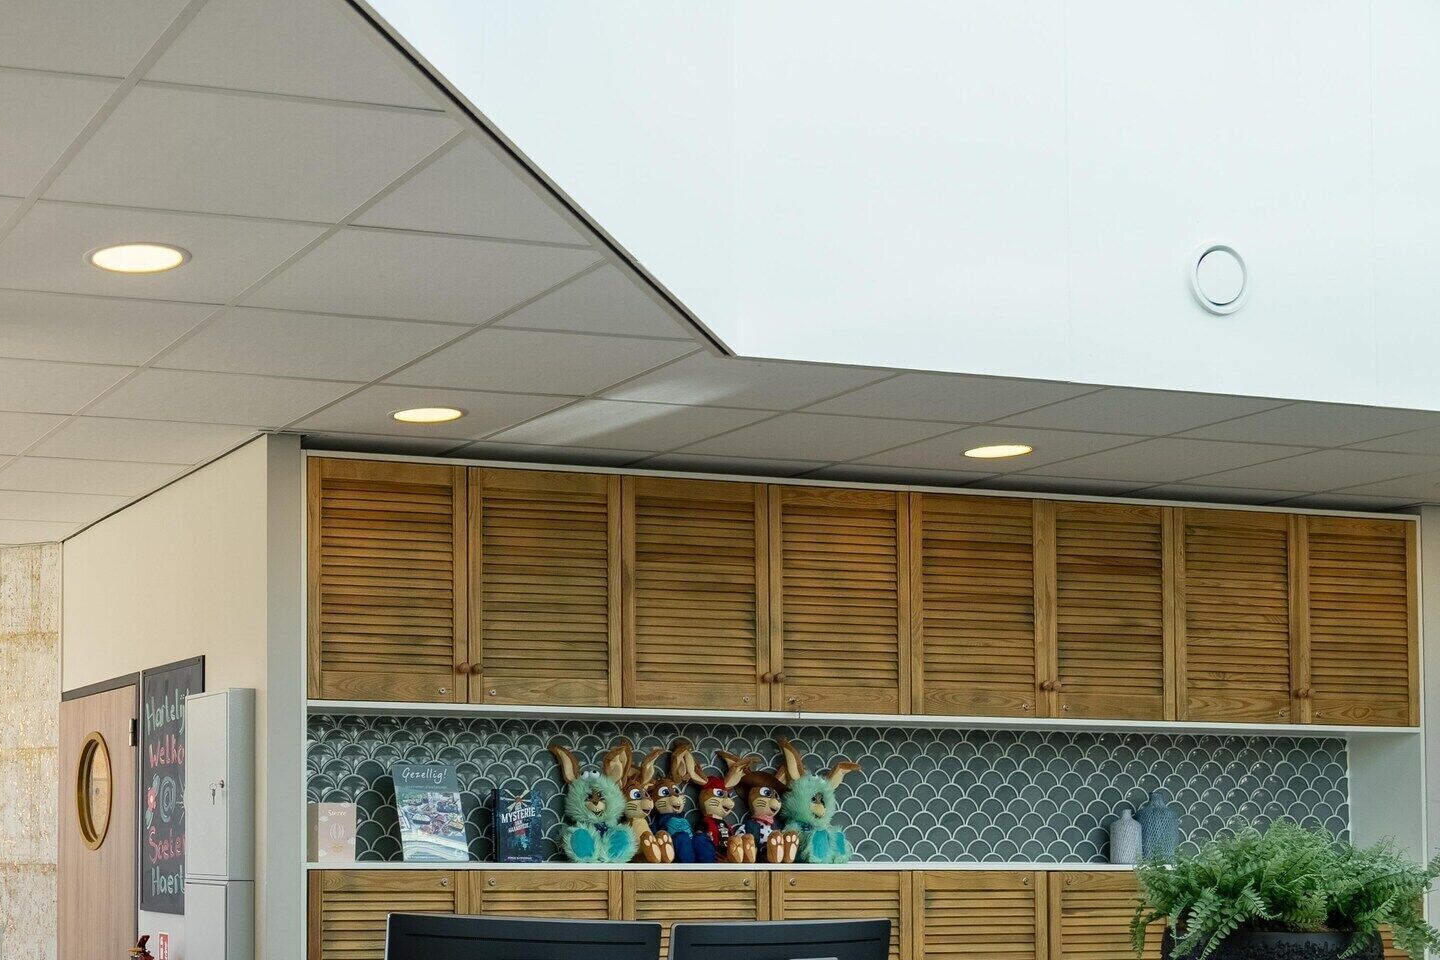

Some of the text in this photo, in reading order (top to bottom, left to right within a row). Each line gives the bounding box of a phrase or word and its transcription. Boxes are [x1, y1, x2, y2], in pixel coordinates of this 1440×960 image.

[146, 688, 189, 735] Hartelij
[149, 734, 185, 768] Welko
[402, 767, 447, 785] Gezellig!
[501, 807, 536, 823] MYSTERIE
